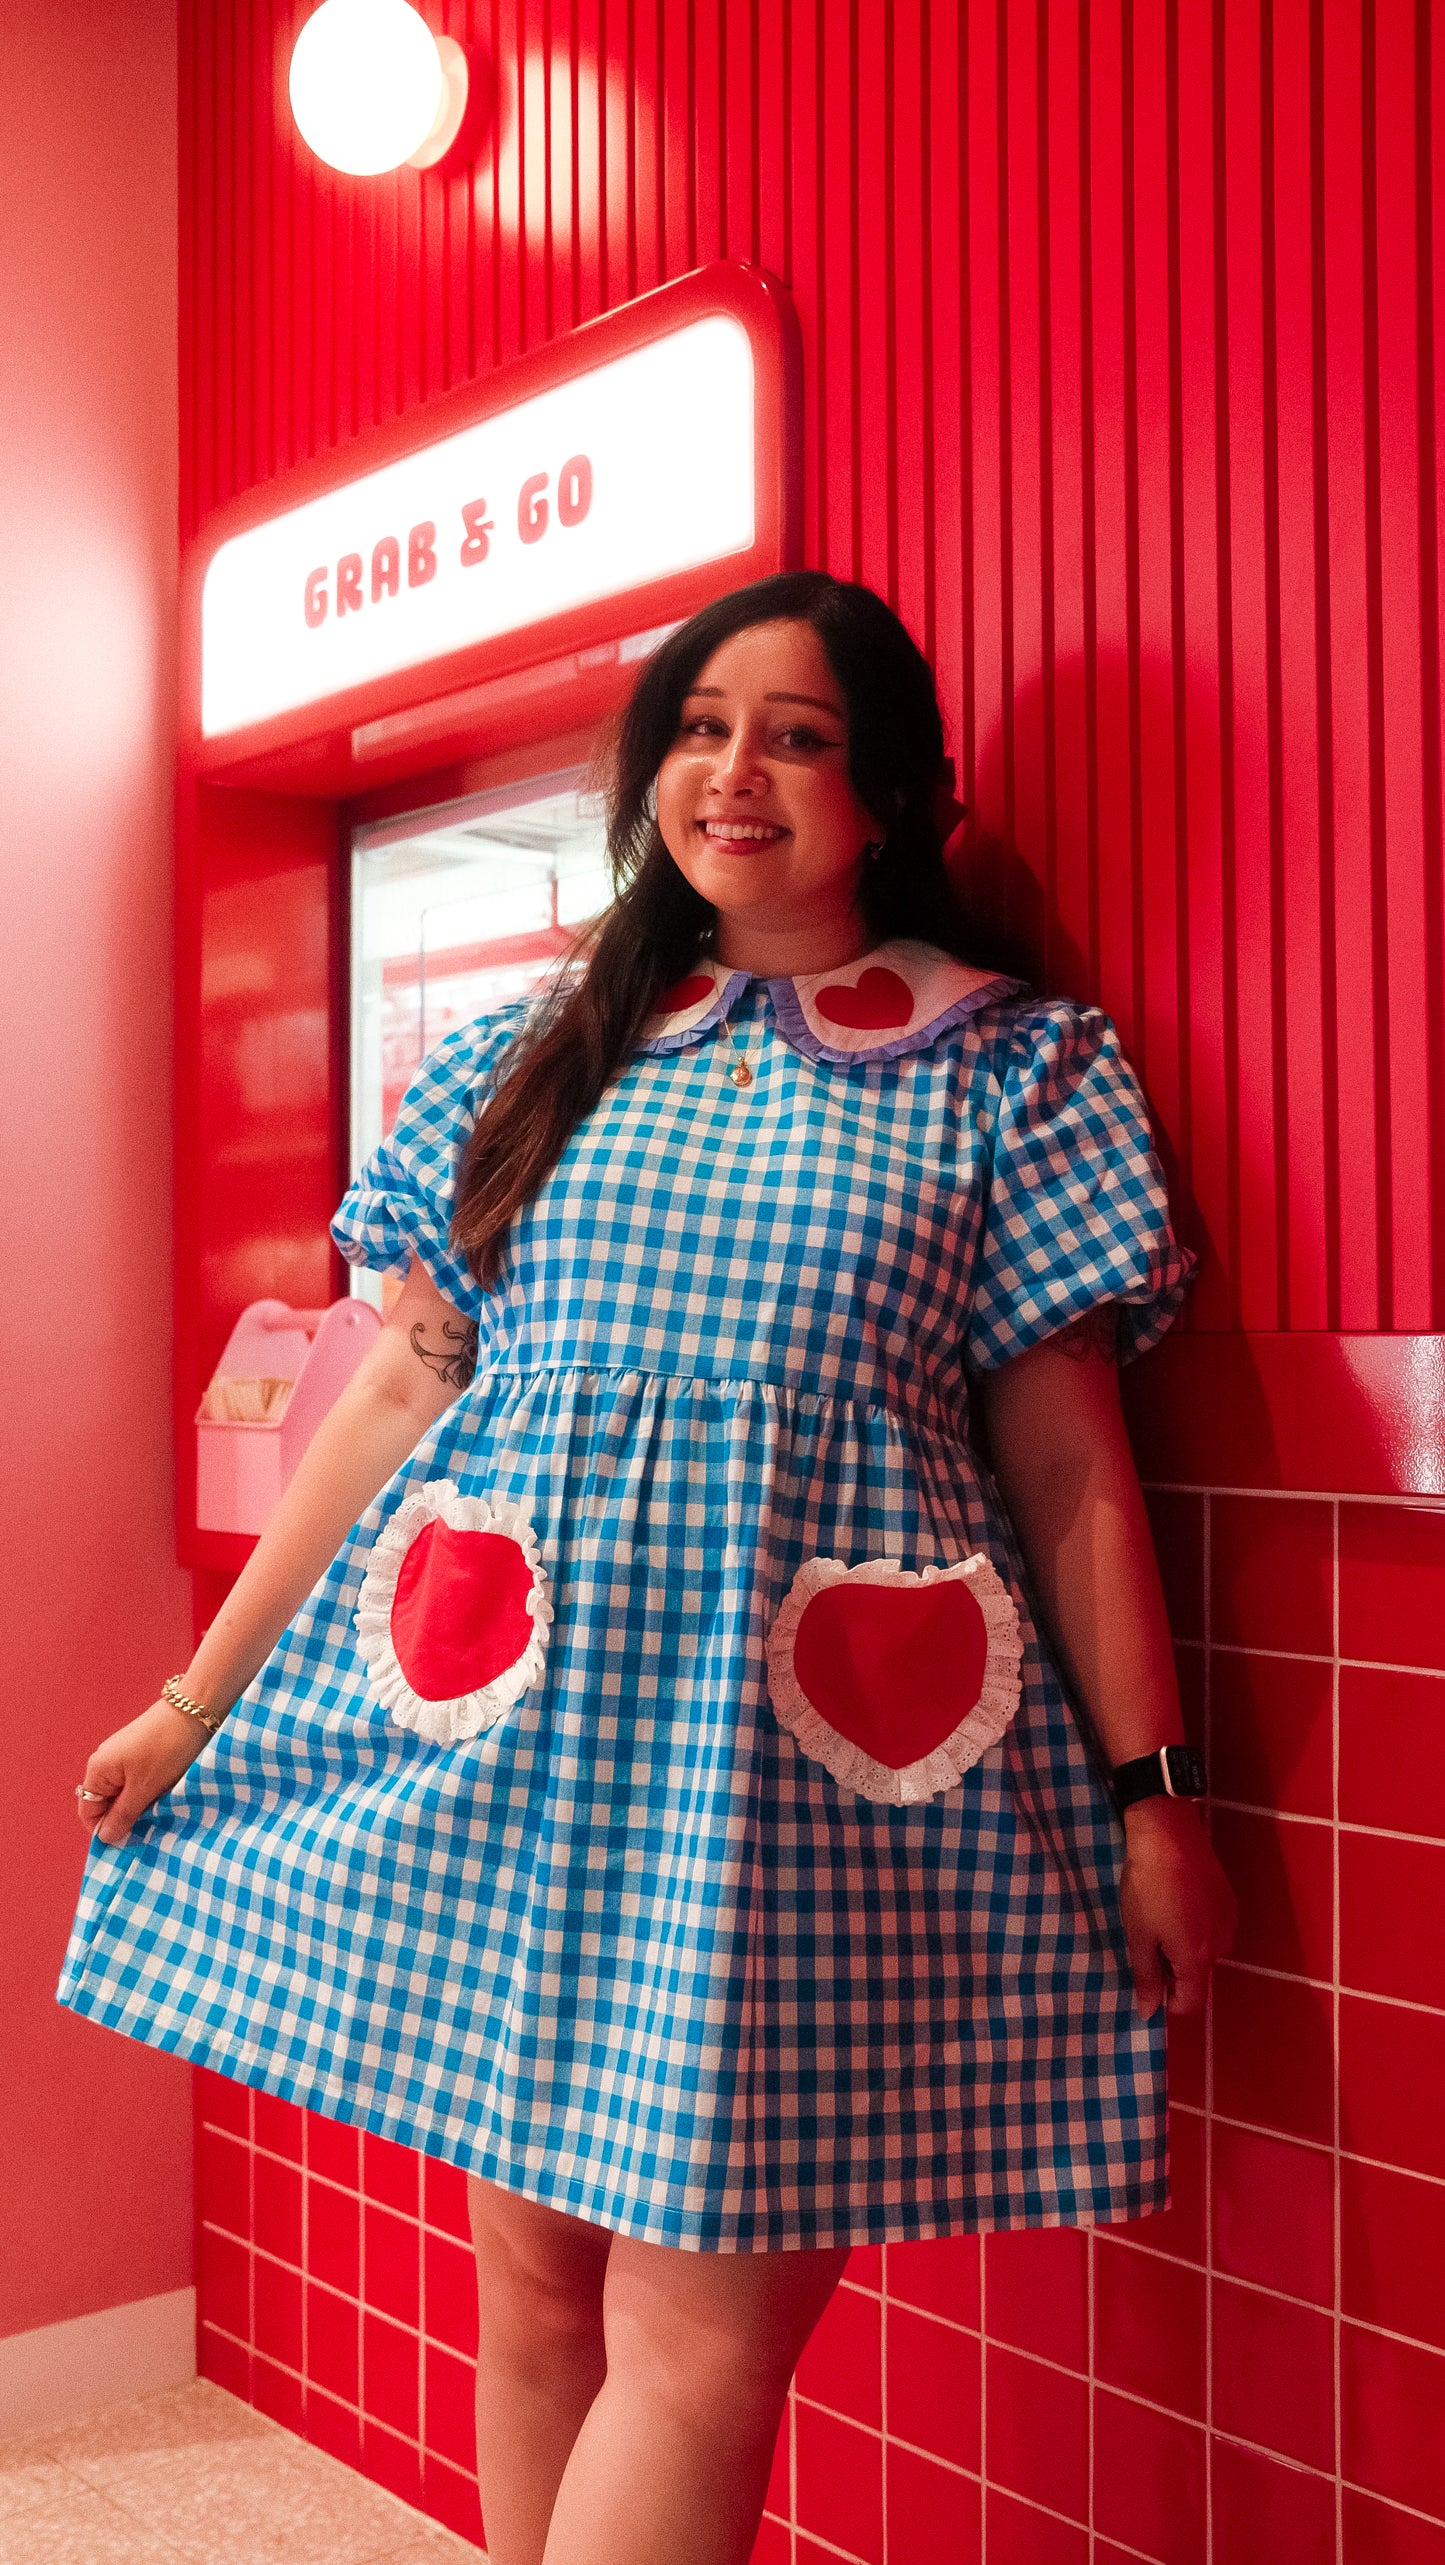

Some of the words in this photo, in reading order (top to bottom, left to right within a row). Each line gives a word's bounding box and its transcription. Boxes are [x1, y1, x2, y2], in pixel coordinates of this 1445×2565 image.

[304, 521, 437, 629] GRAB
[460, 497, 495, 568] &
[517, 454, 594, 550] GO
